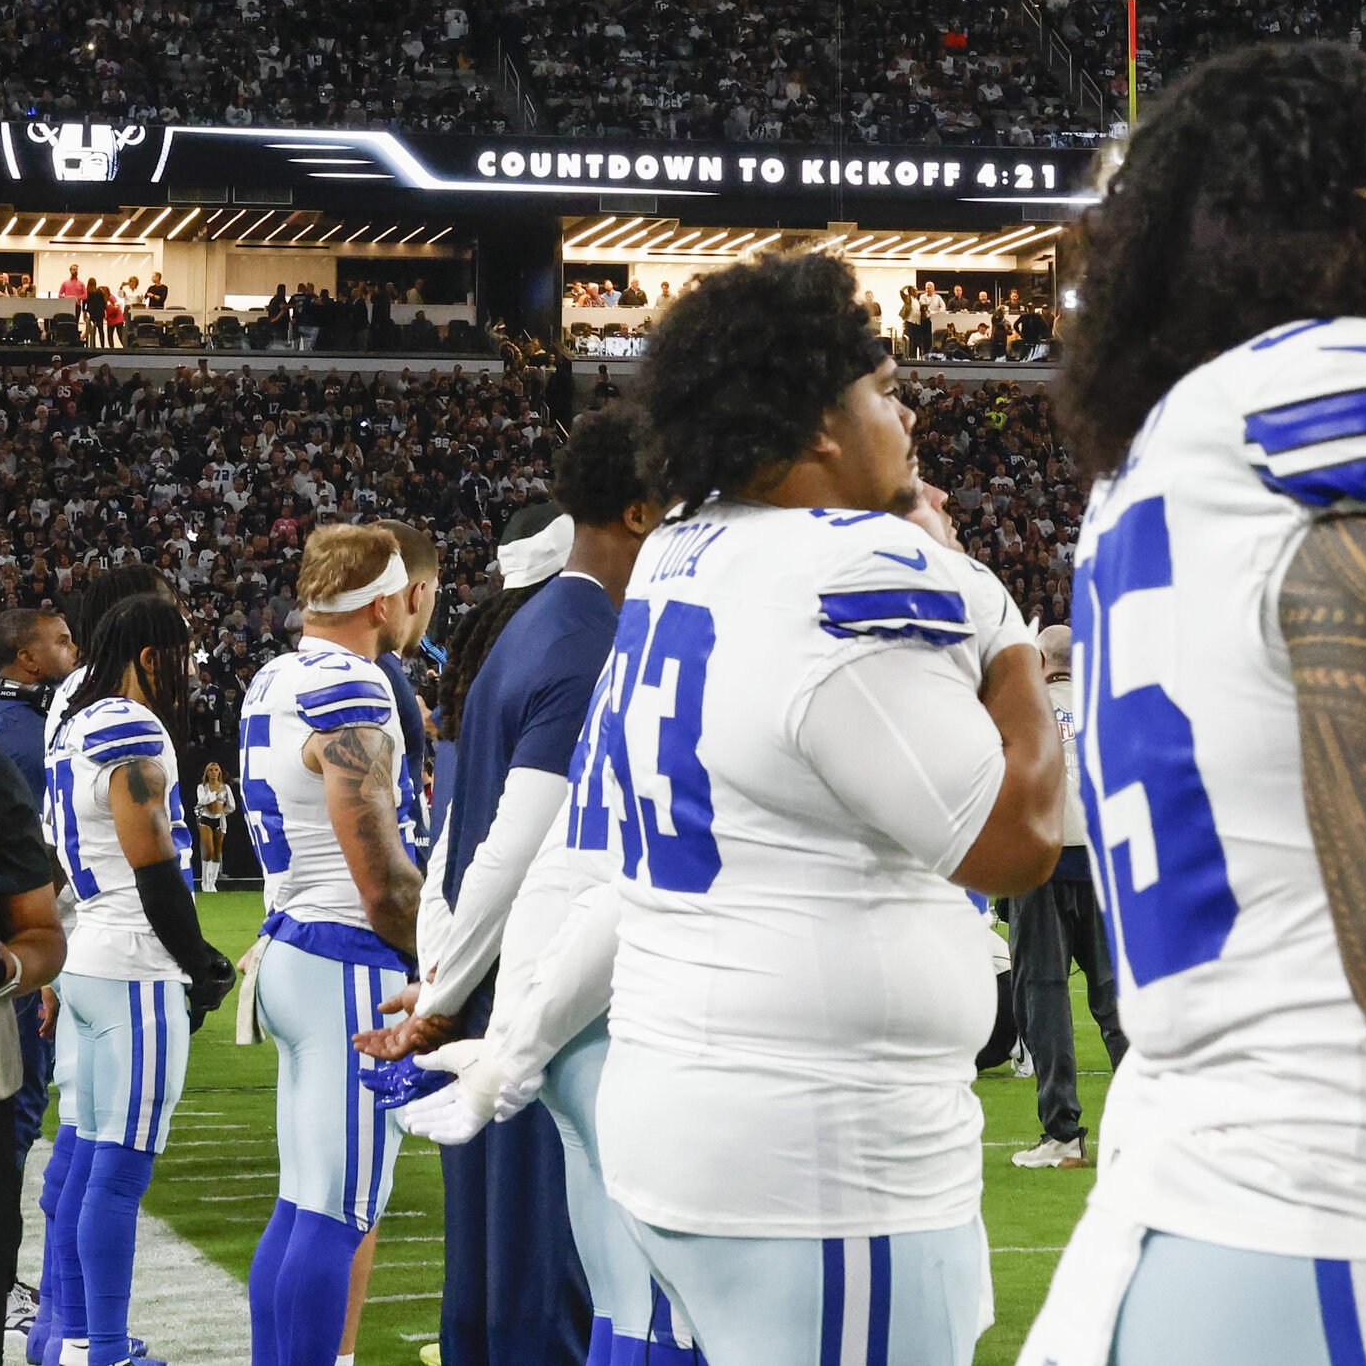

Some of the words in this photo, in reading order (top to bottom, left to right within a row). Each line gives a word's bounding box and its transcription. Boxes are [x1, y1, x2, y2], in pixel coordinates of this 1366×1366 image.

[477, 150, 723, 182] COUNTDOWN
[738, 157, 785, 184] TO
[801, 158, 961, 187] KICKOFF
[976, 162, 1057, 190] 4:21
[214, 470, 229, 481] 72
